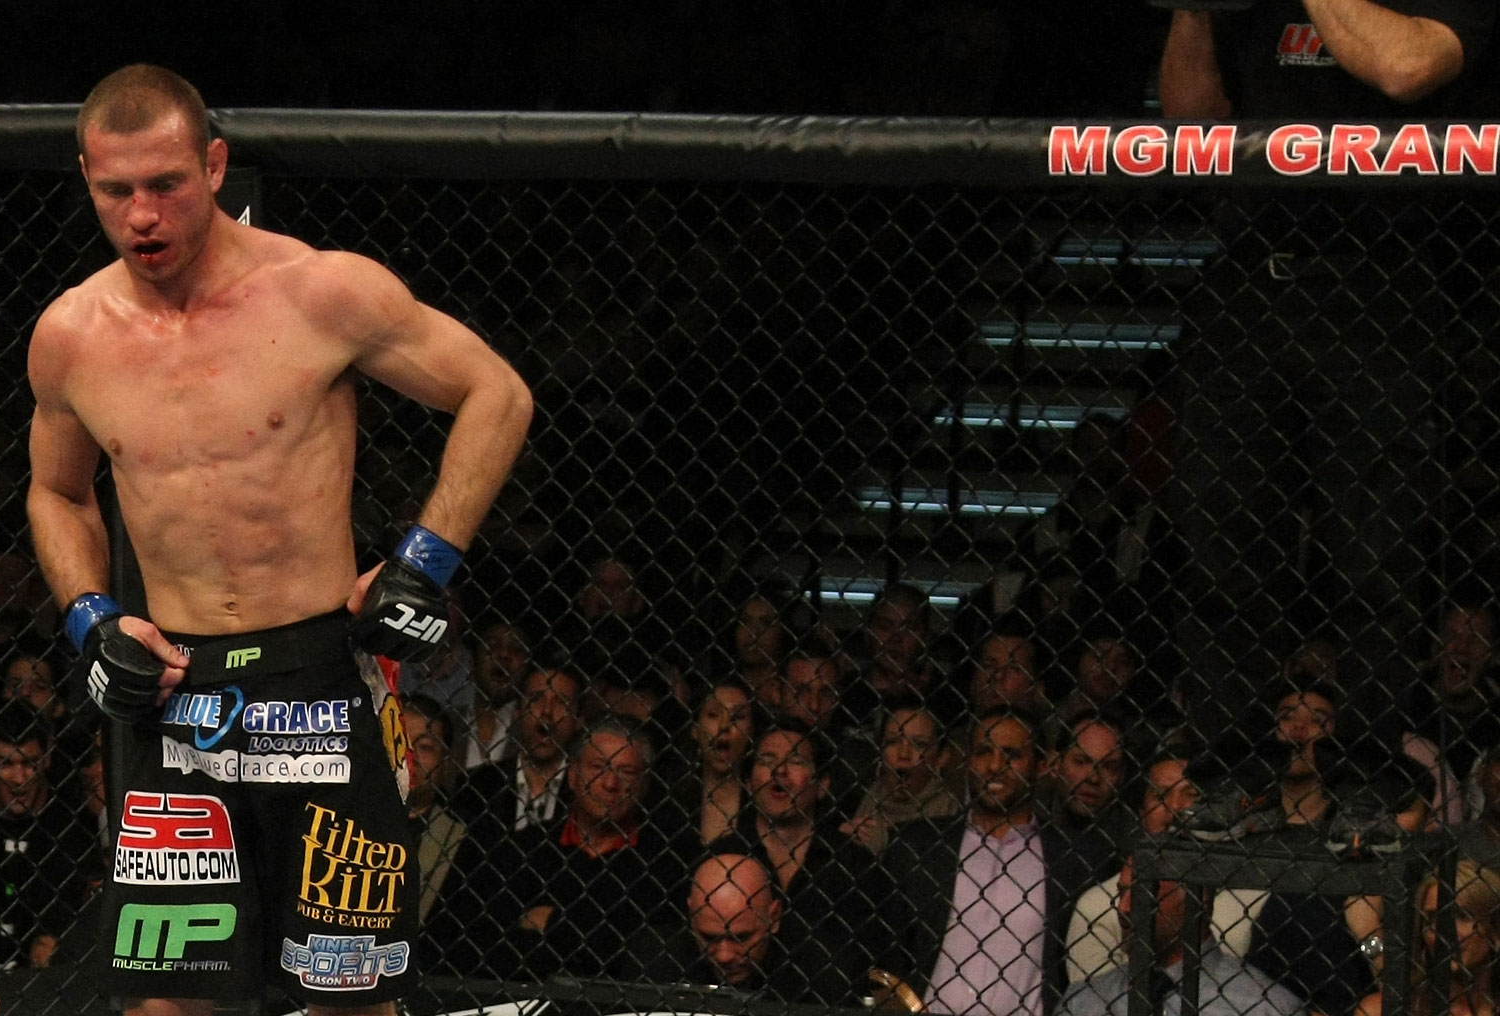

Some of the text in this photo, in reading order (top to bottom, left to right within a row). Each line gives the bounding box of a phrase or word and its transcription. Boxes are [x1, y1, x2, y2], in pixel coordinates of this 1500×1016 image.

[1048, 124, 1500, 176] MGM GRAN
[383, 602, 449, 644] UFC
[160, 693, 222, 729] BLUE
[242, 699, 351, 735] GRACE
[248, 735, 349, 752] LOGISTICS
[116, 847, 237, 881] SAFEAUTO.COM
[322, 908, 335, 924] &
[280, 940, 409, 978] SPORTS
[310, 936, 375, 953] KINECT
[304, 973, 371, 986] SEASON TWO
